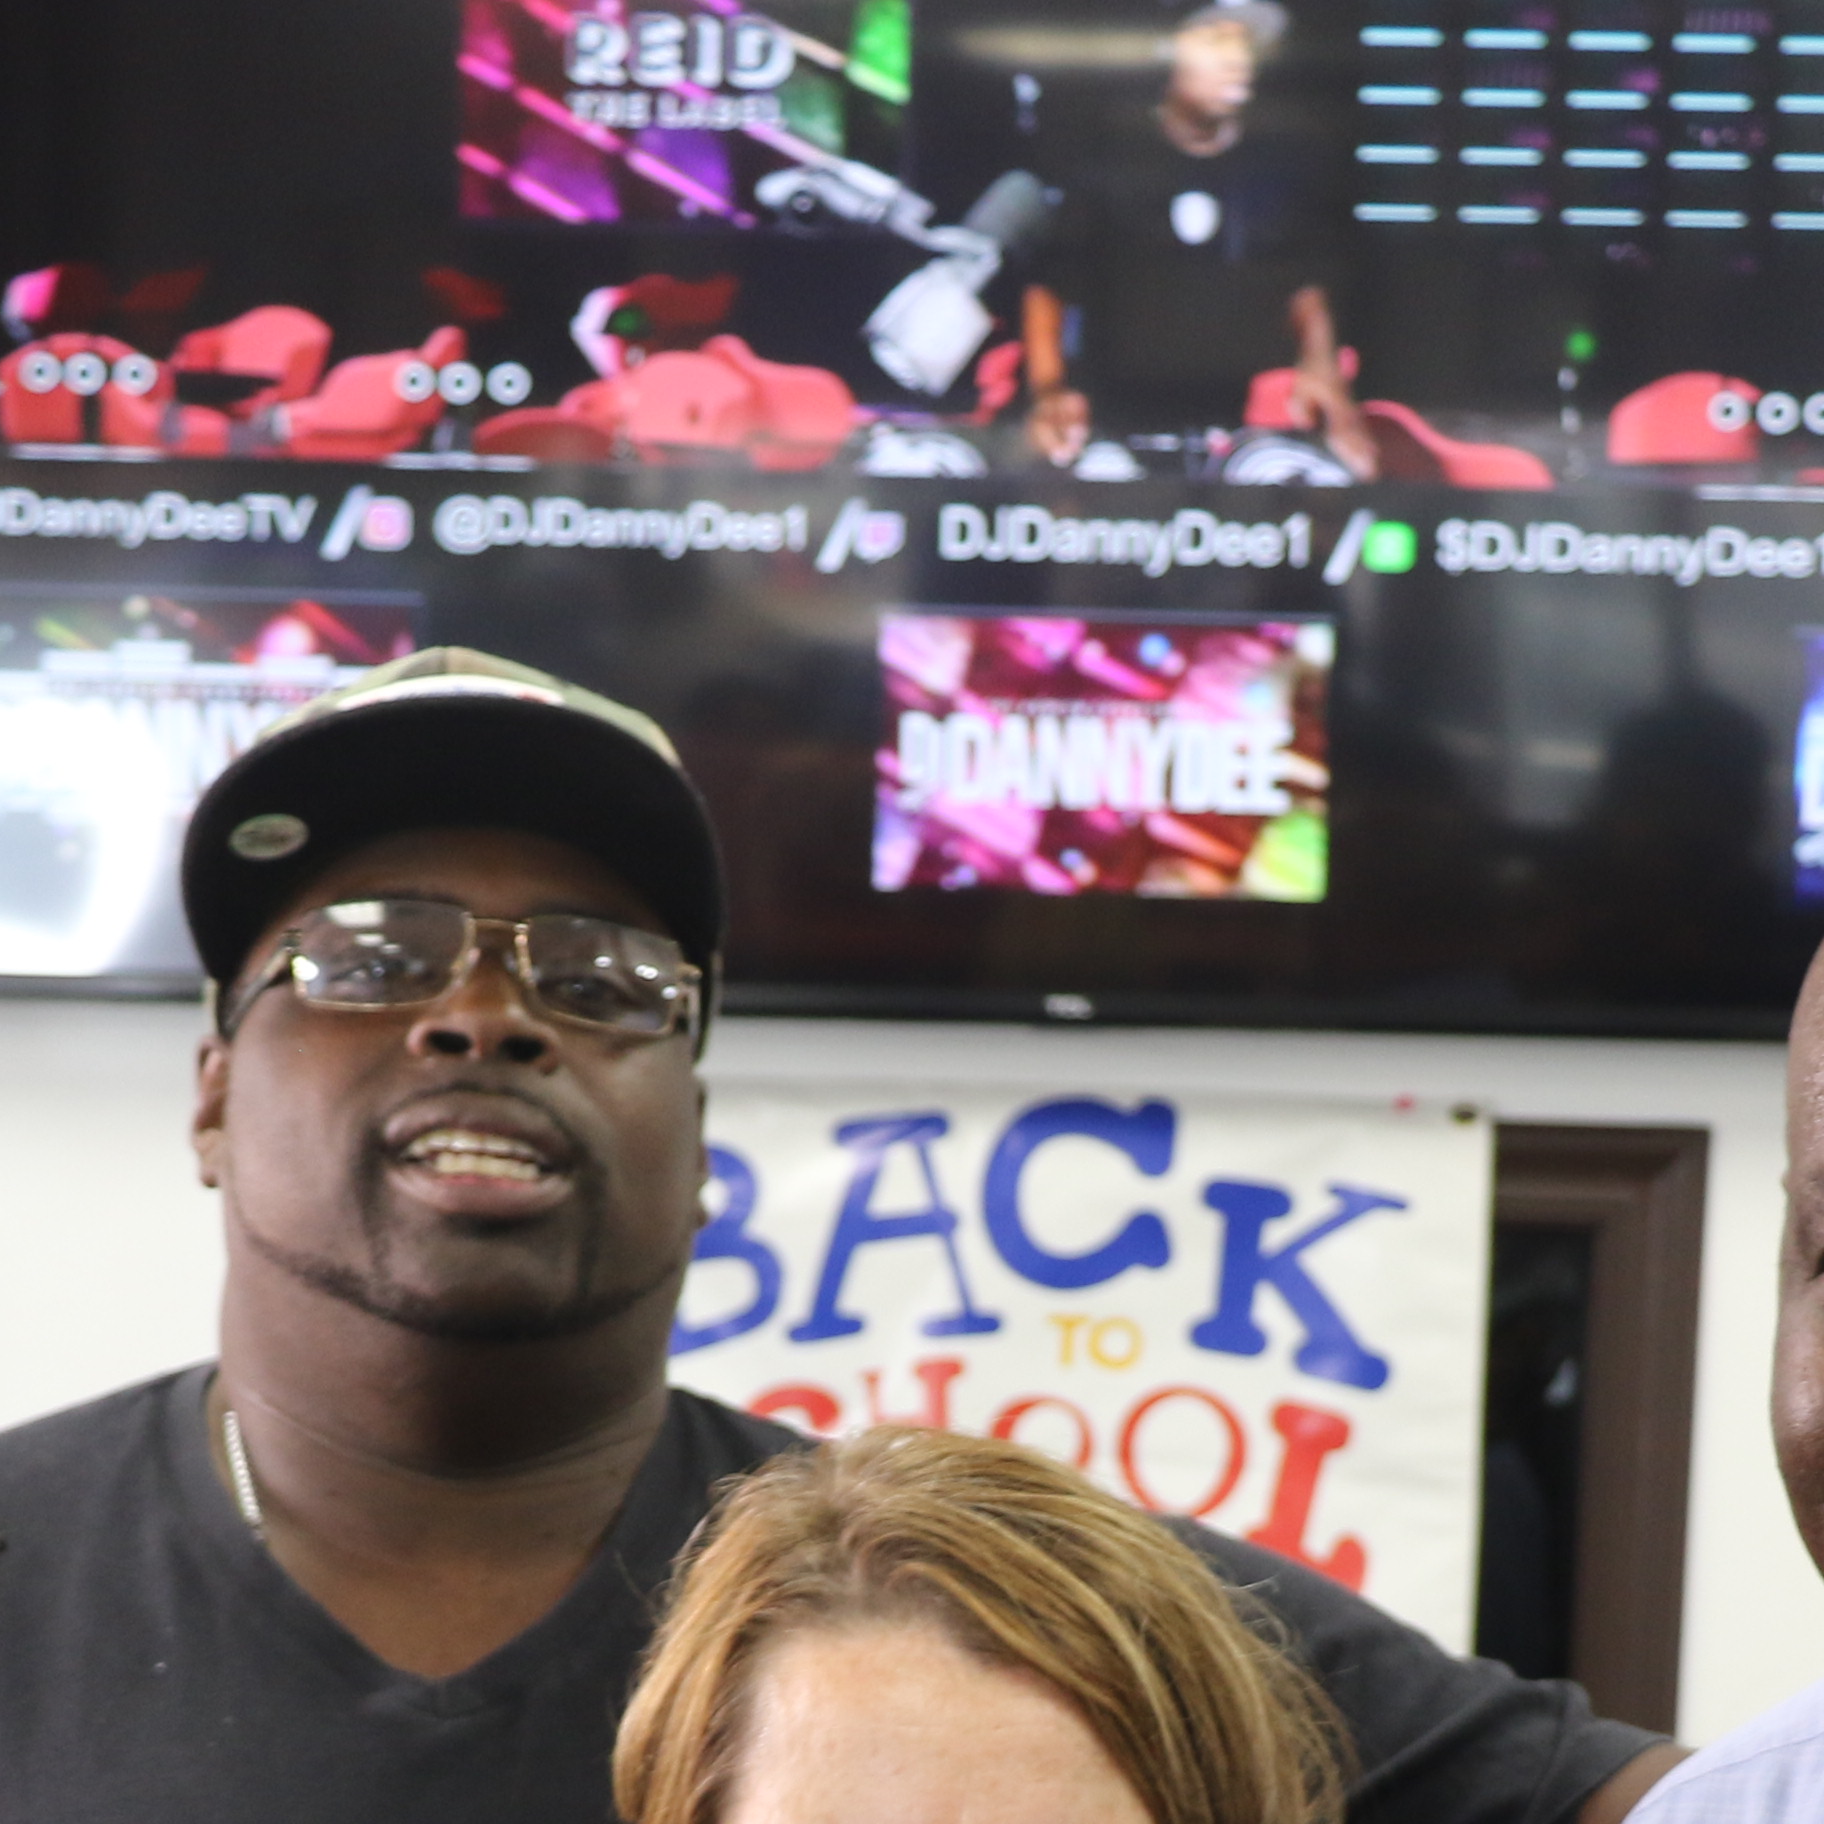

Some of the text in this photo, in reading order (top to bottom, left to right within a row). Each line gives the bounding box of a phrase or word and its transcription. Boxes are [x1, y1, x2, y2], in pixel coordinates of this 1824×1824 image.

[433, 494, 808, 560] @DJDannyDee1
[938, 503, 1311, 577] DJDannyDee1
[670, 1097, 1407, 1391] BACK
[1049, 1314, 1143, 1370] TO
